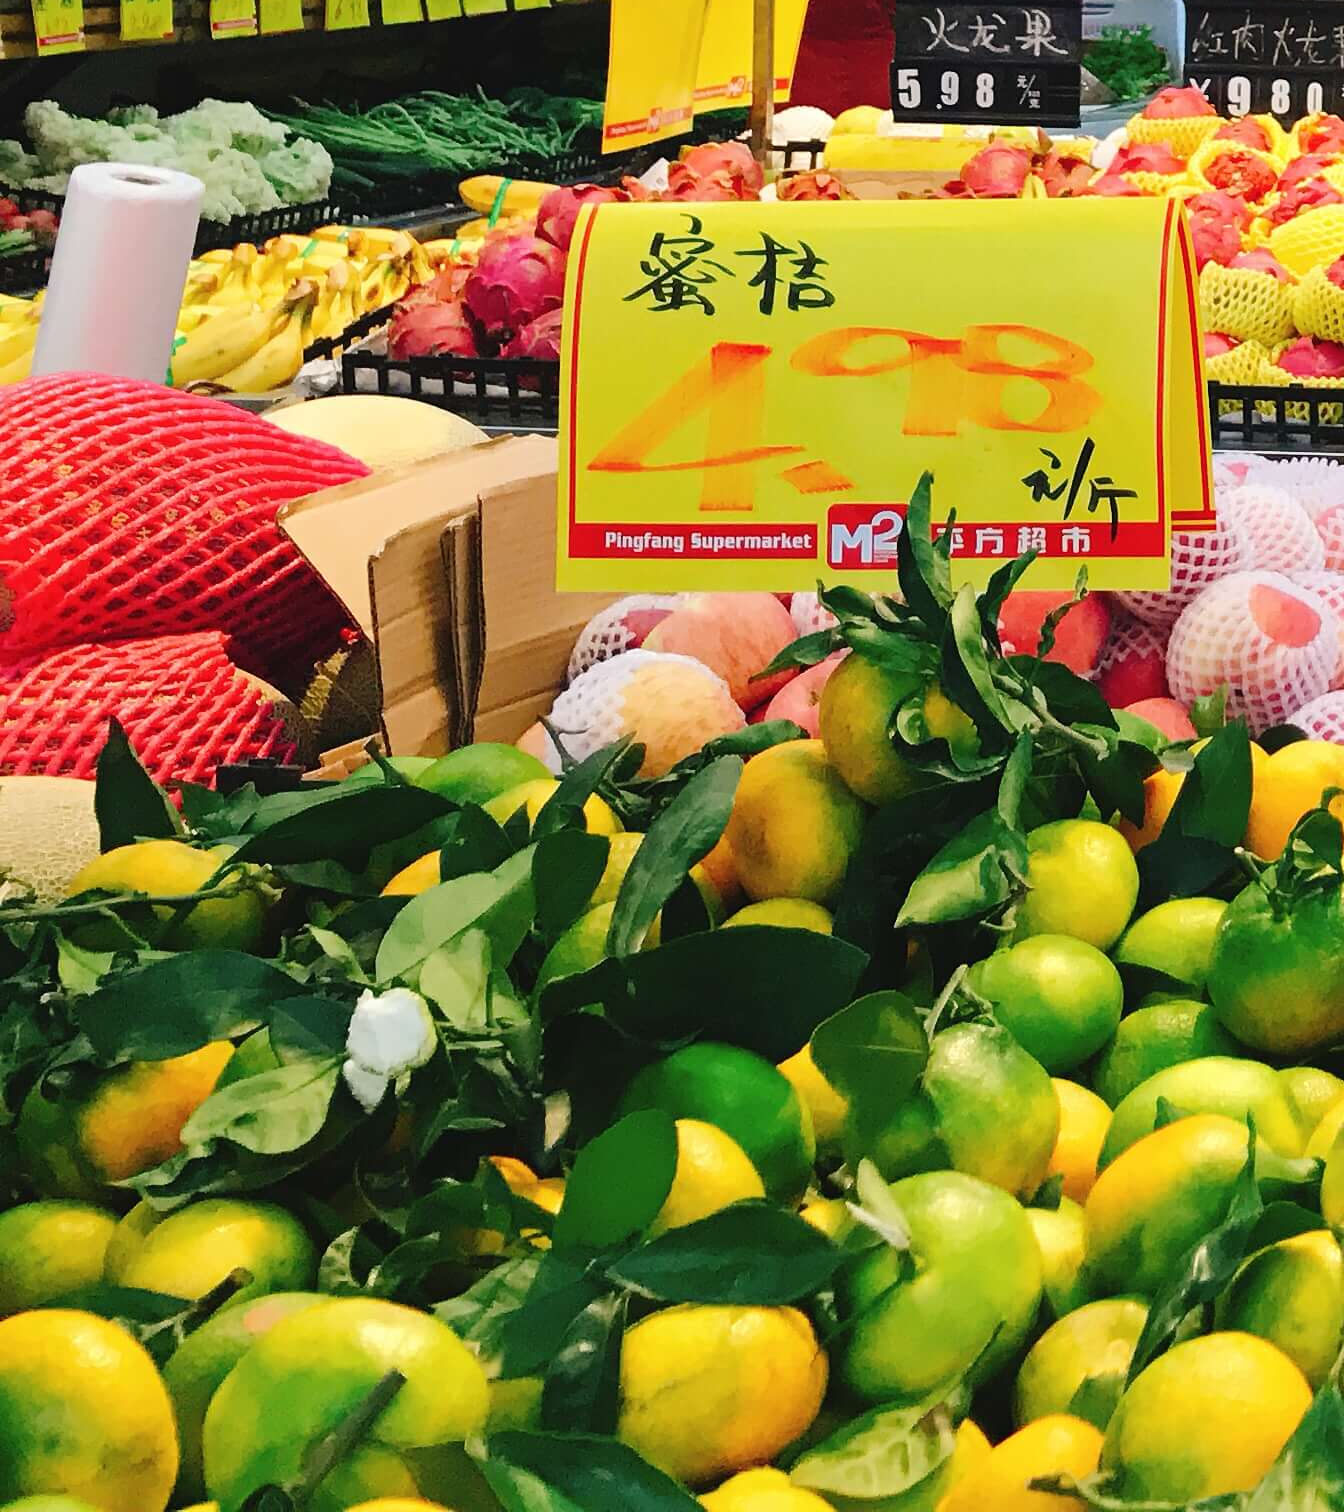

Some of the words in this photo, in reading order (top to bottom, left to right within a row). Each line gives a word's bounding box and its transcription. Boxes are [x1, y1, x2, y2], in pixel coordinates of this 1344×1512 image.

[921, 9, 1069, 56] 火龙果
[898, 69, 994, 110] 5.98
[622, 213, 836, 317] 蜜桔
[586, 324, 1103, 512] 4.98
[1022, 437, 1138, 541] 元/斤
[604, 530, 685, 555] Pingfang
[690, 530, 813, 552] Supermarket
[831, 510, 904, 564] M2
